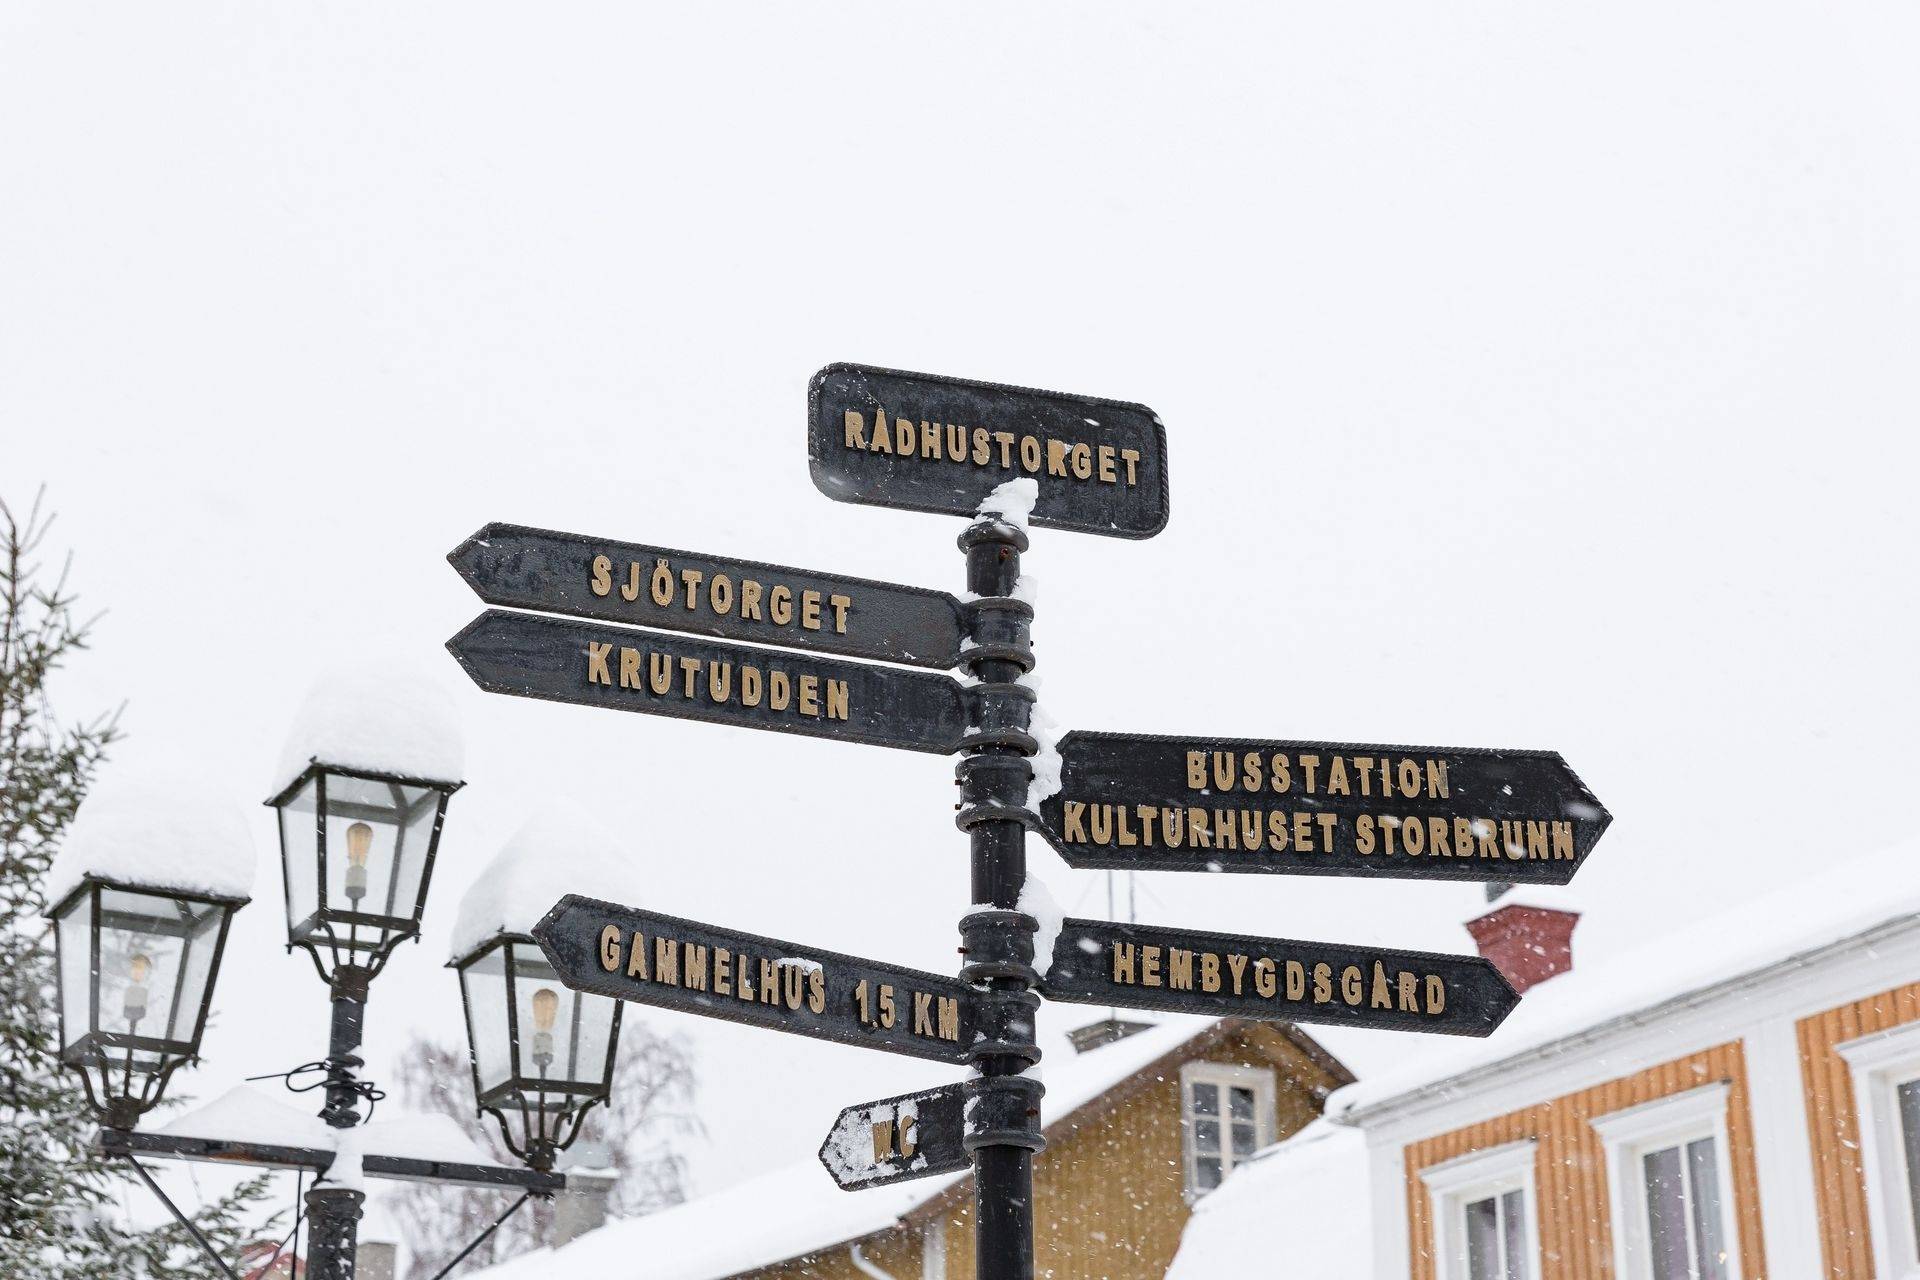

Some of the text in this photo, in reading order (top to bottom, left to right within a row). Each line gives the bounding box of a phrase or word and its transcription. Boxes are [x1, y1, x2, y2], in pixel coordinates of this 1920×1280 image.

[844, 408, 1141, 485] RÅDHUSTORGET
[591, 554, 851, 635] SJÖTORGET
[588, 641, 850, 721] KRUTUDDEN
[1186, 750, 1450, 799] BUSSTATION
[1064, 800, 1574, 861] KULTURHUSET STORBRUNN
[600, 924, 825, 1015] GAMMELHUS
[914, 991, 959, 1042] KM
[1113, 941, 1446, 1015] HEMBYGDSGÅRD
[872, 1115, 917, 1164] WC
